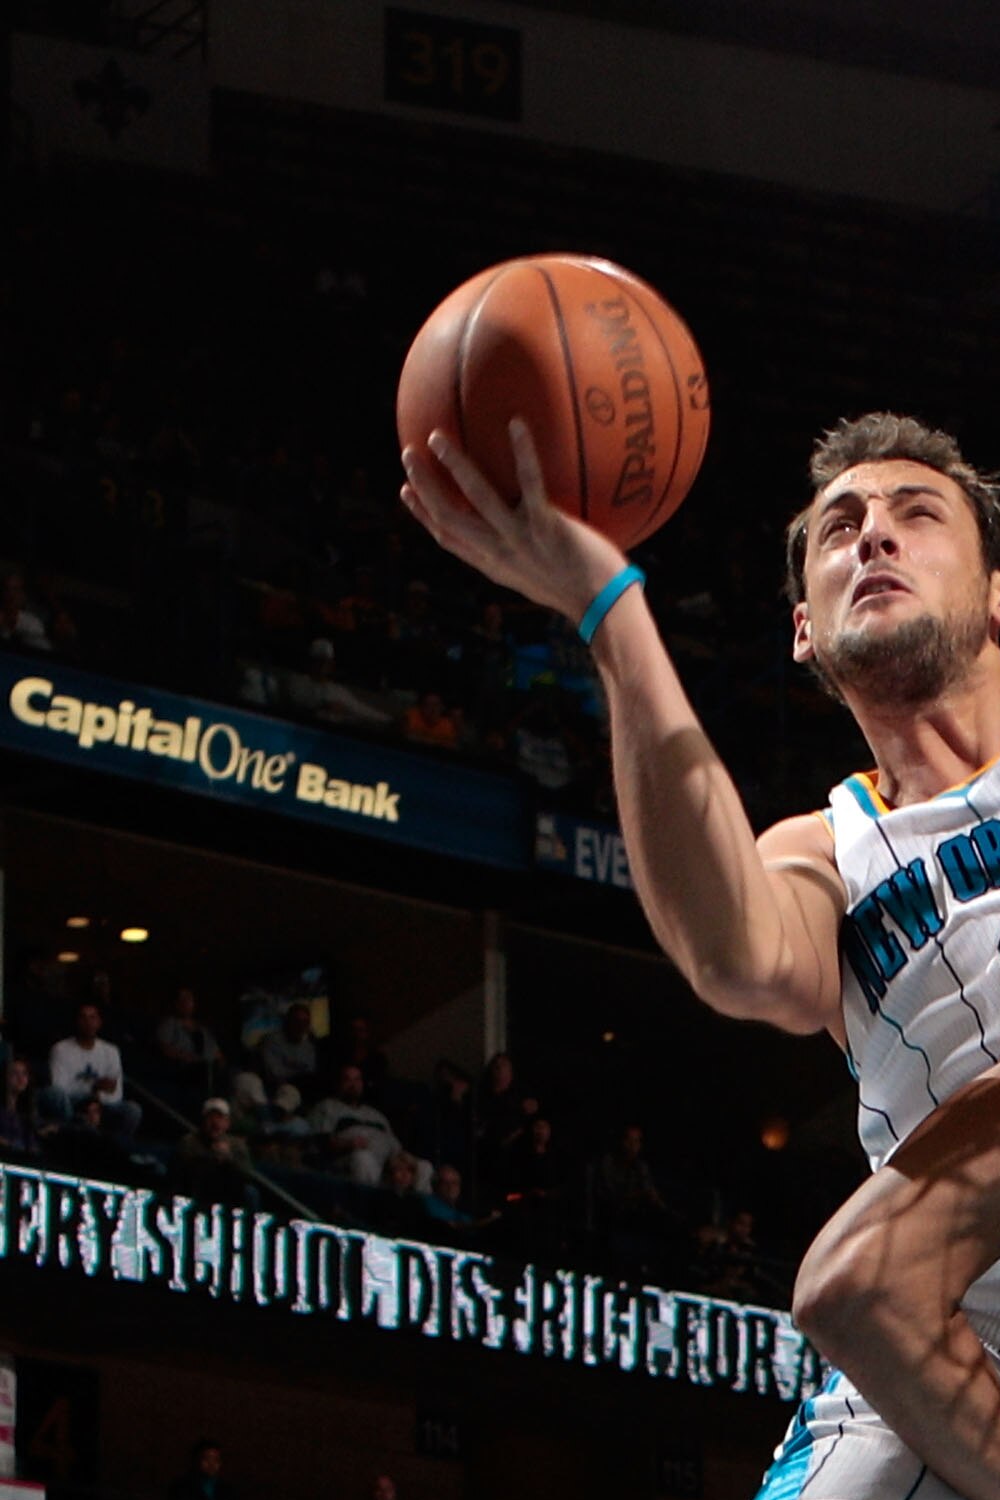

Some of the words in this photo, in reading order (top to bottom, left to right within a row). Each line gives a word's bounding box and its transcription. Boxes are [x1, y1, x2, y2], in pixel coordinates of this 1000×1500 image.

[402, 30, 511, 97] 319
[593, 296, 656, 506] SPALDING
[295, 762, 401, 823] Bank
[841, 858, 945, 1016] NEW
[29, 1395, 78, 1480] 4
